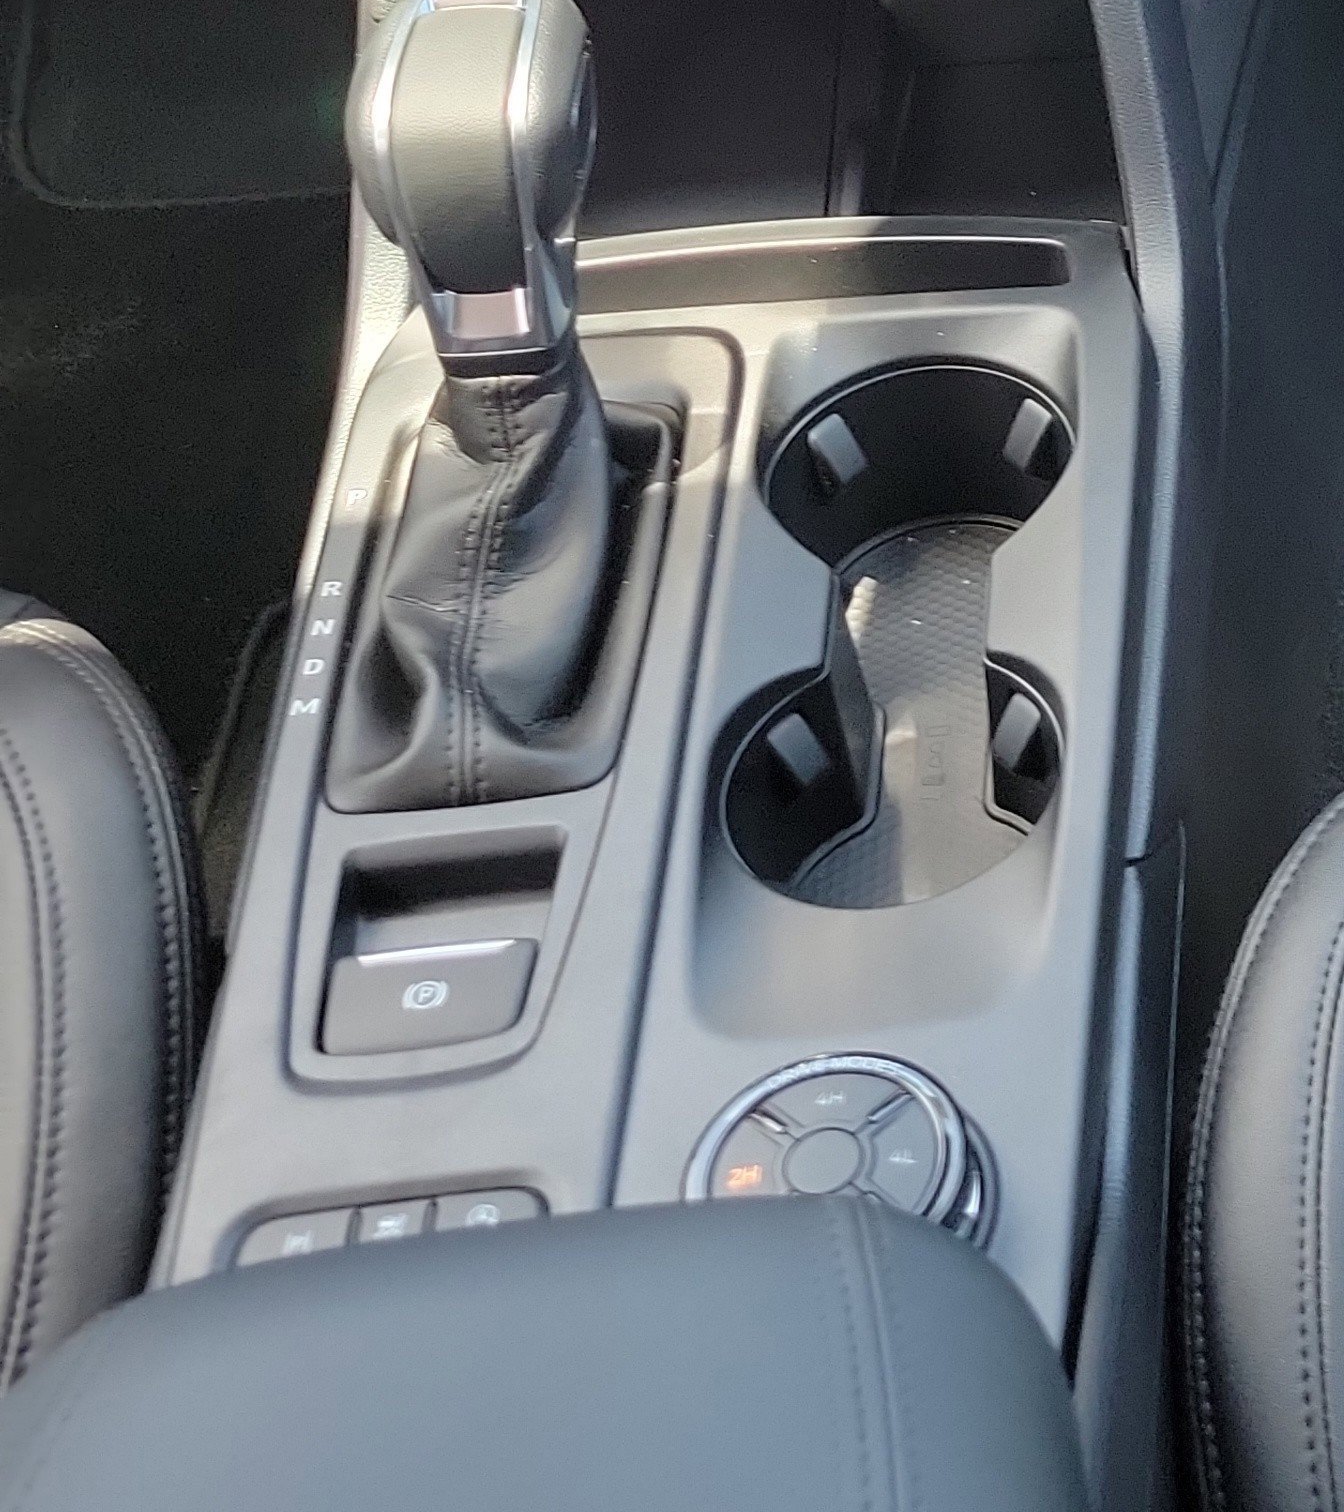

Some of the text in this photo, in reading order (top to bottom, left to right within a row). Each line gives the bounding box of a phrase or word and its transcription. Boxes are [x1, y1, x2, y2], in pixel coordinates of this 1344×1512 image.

[320, 580, 342, 597] R
[310, 619, 335, 636] N
[302, 659, 325, 675] D
[289, 697, 320, 716] M
[814, 1091, 844, 1105] 4H
[726, 1164, 763, 1188] 2H
